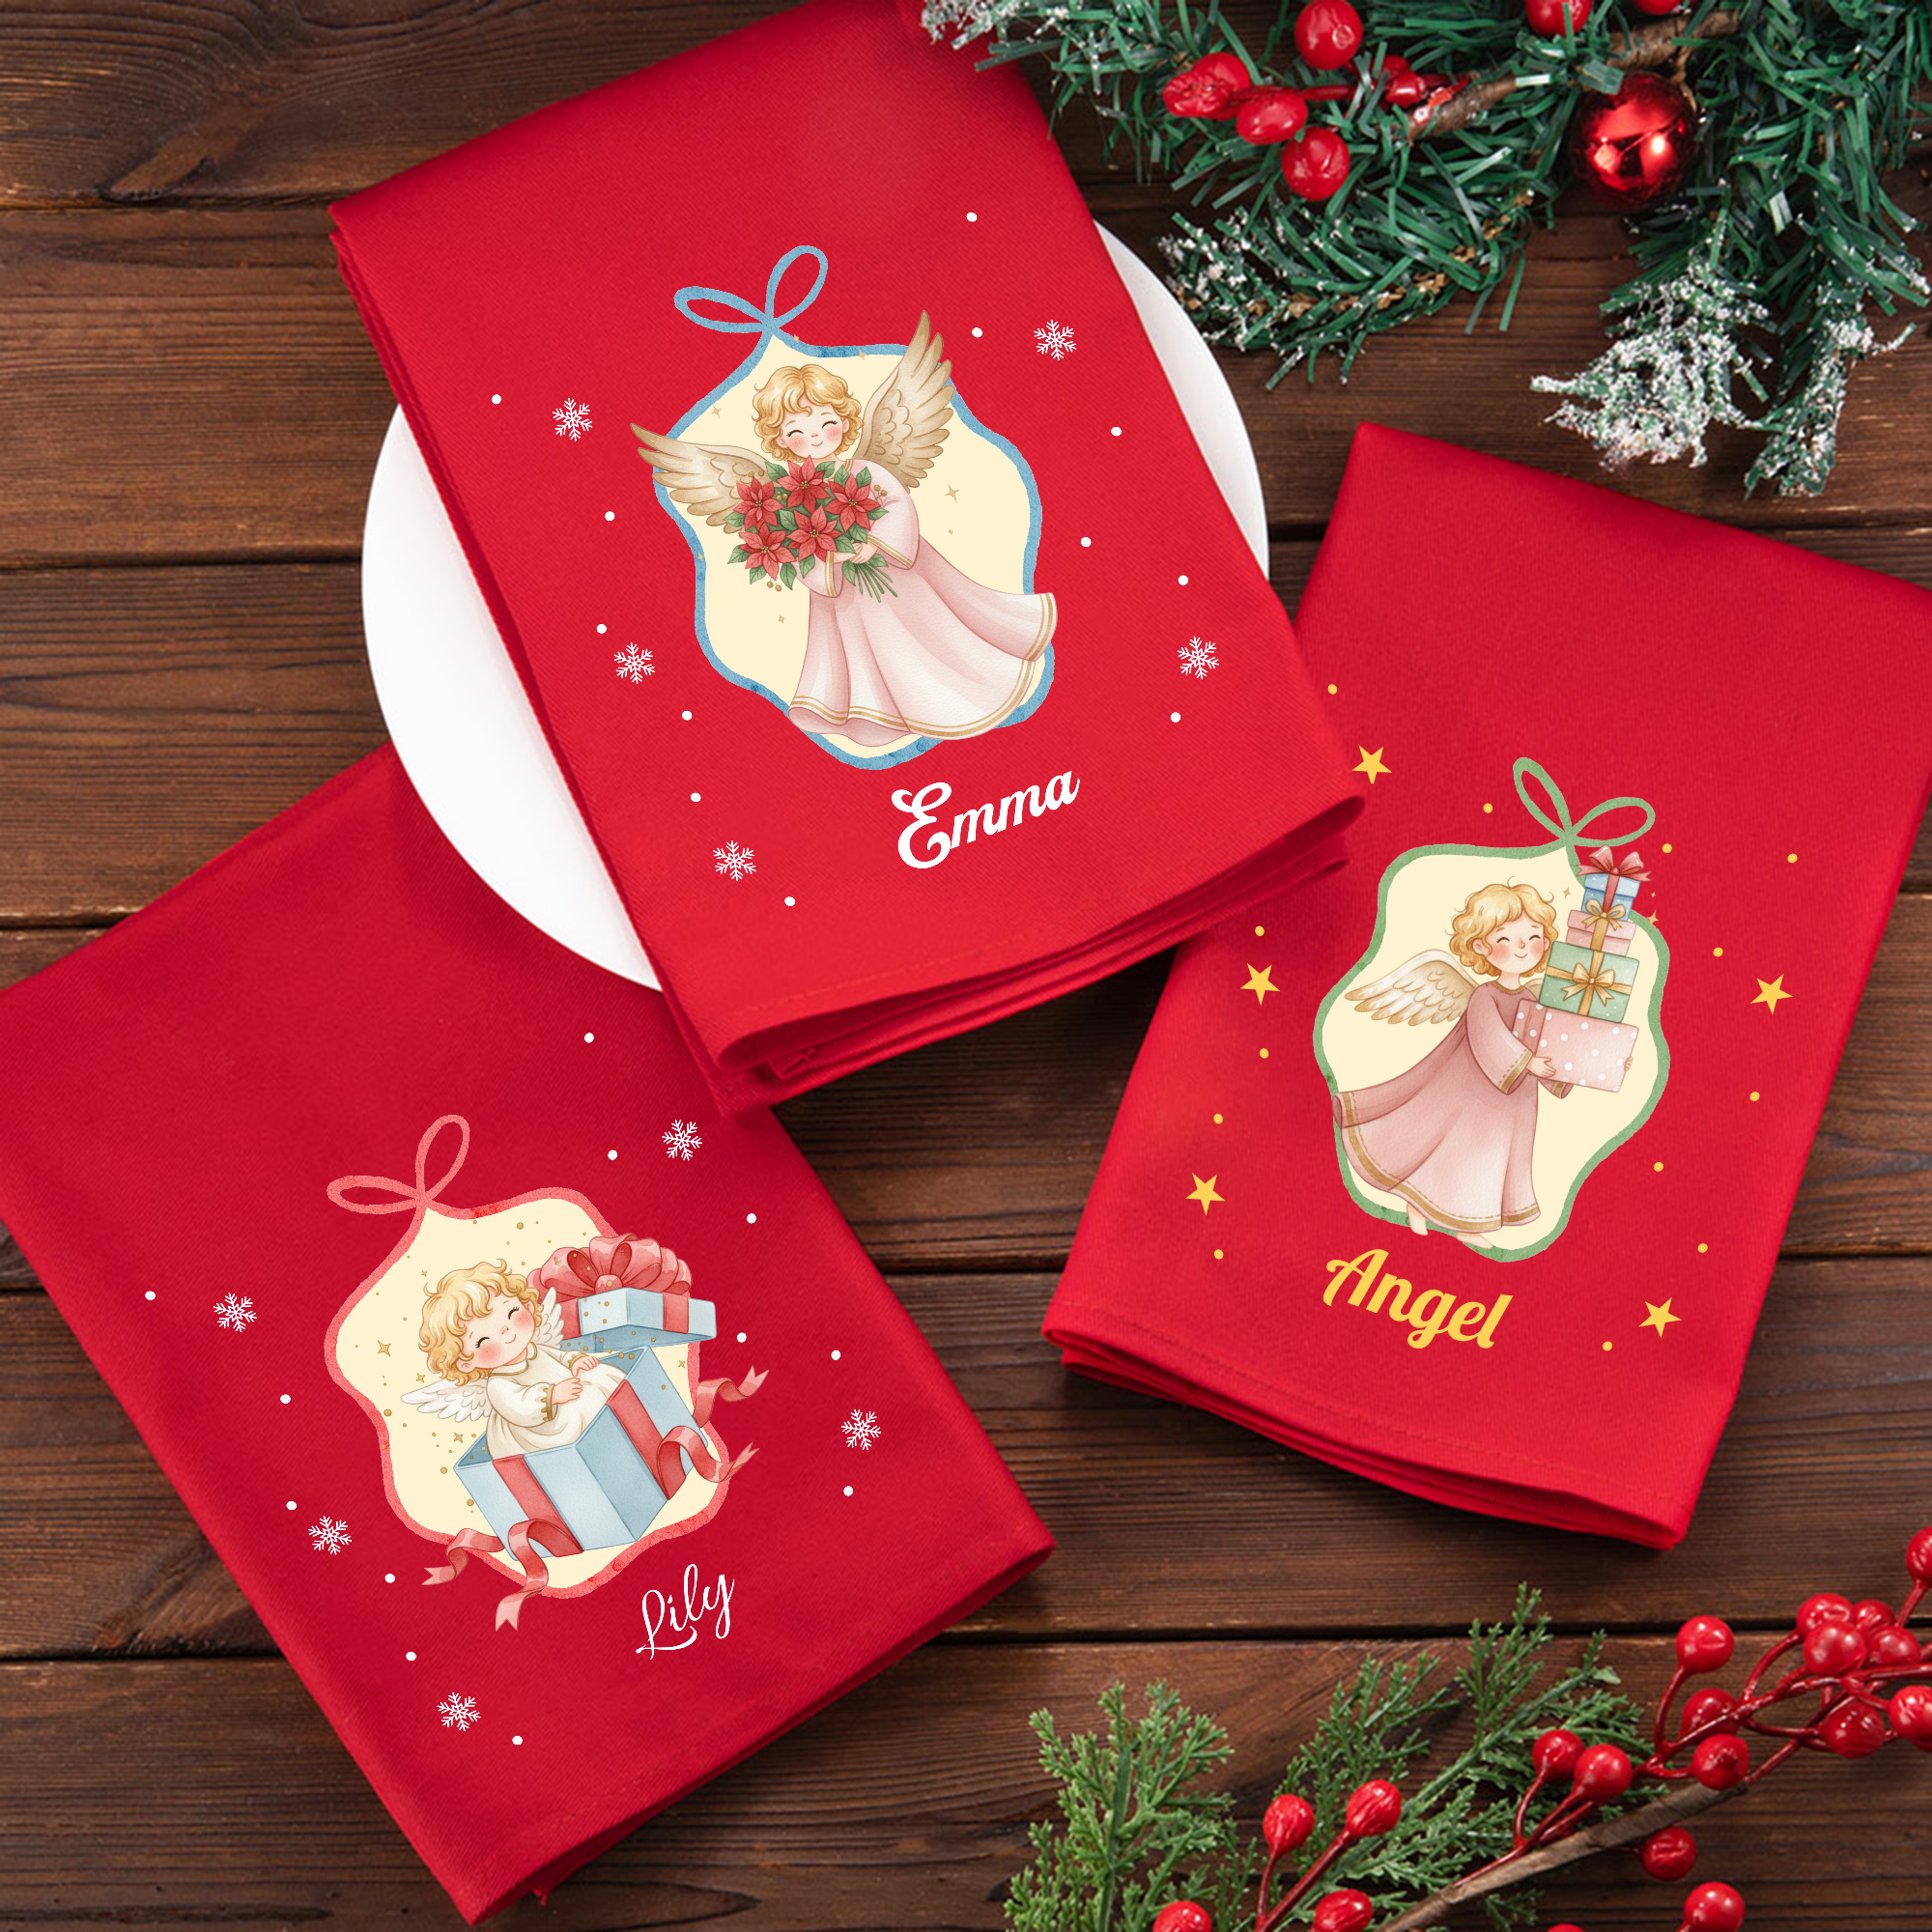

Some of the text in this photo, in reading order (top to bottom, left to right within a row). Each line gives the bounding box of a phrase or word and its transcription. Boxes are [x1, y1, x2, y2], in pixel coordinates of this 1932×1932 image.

[891, 770, 1080, 869] Emma
[1322, 1248, 1514, 1350] Angel
[635, 1563, 735, 1661] Lily
